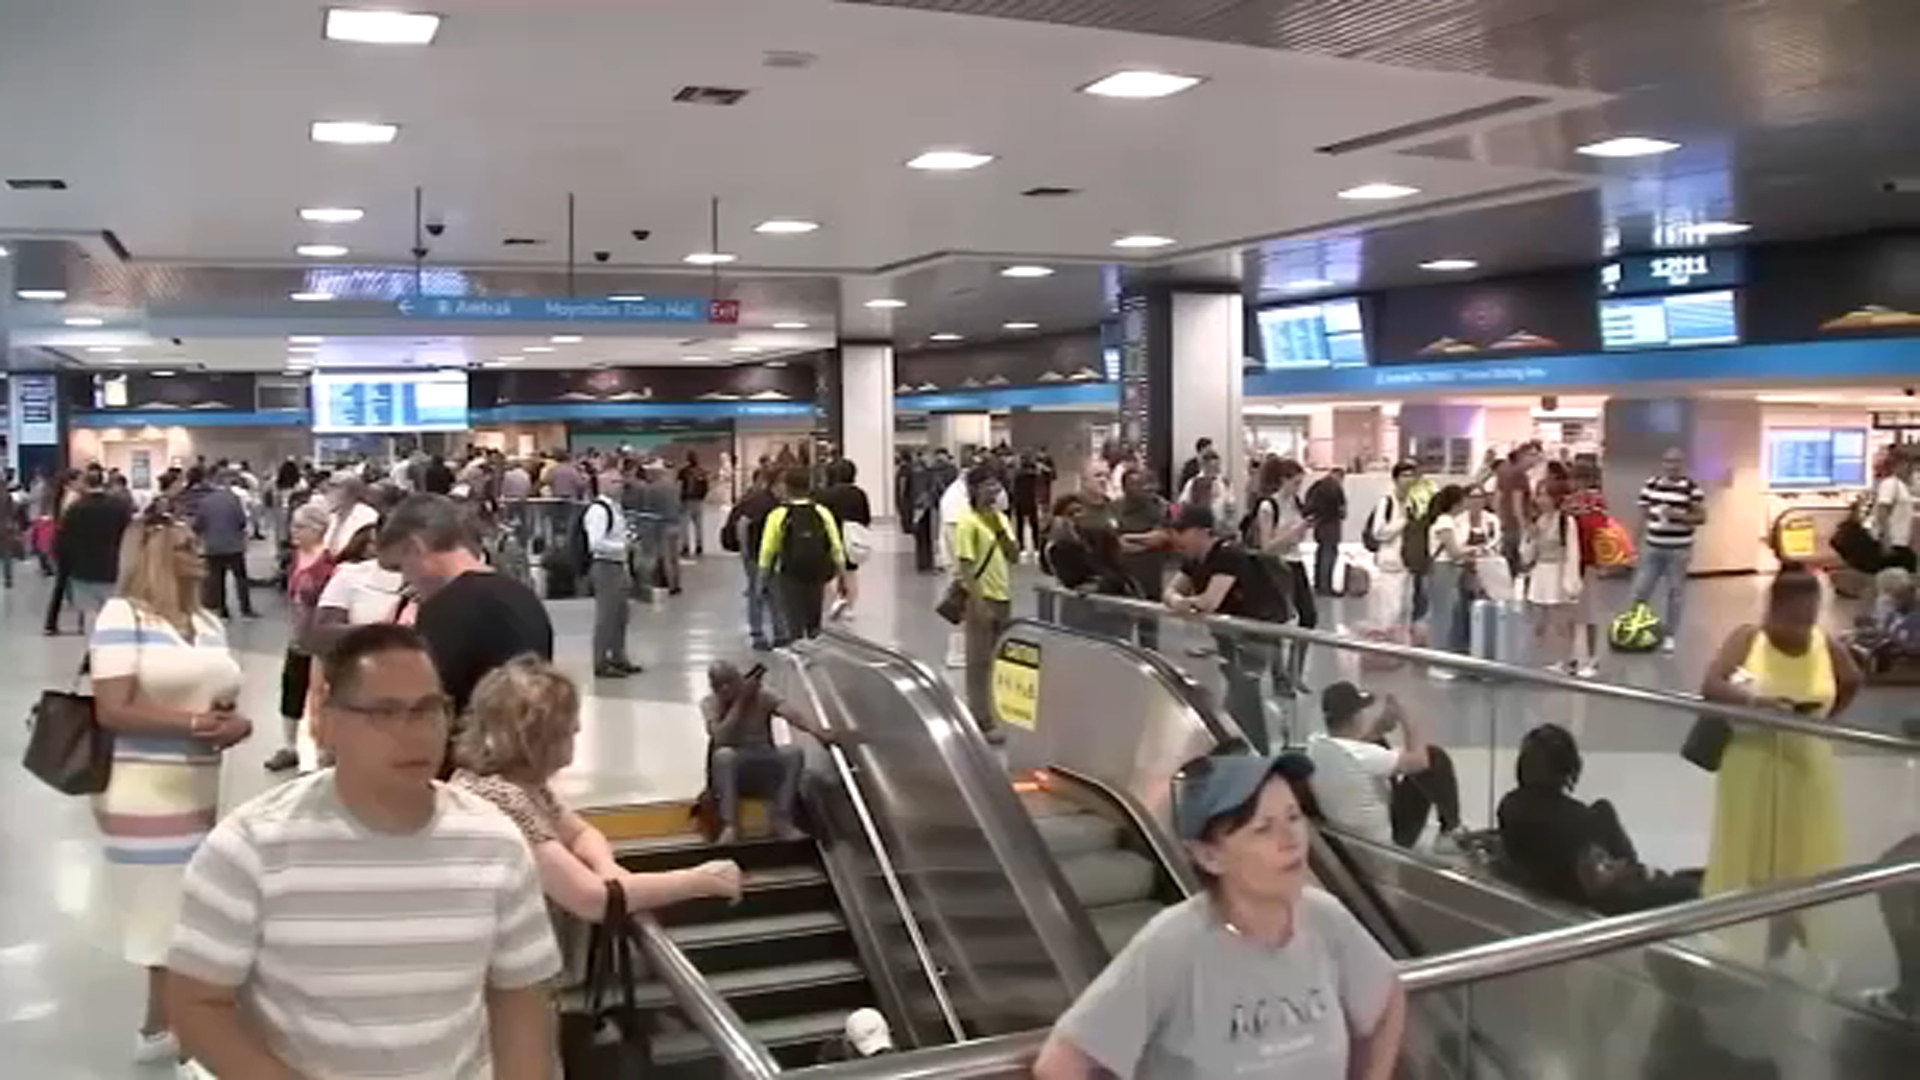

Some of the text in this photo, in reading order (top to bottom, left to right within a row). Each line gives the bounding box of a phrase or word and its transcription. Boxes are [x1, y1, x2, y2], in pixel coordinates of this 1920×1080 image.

[455, 300, 512, 315] Amtrak
[622, 301, 660, 317] Train
[711, 302, 738, 319] Exit
